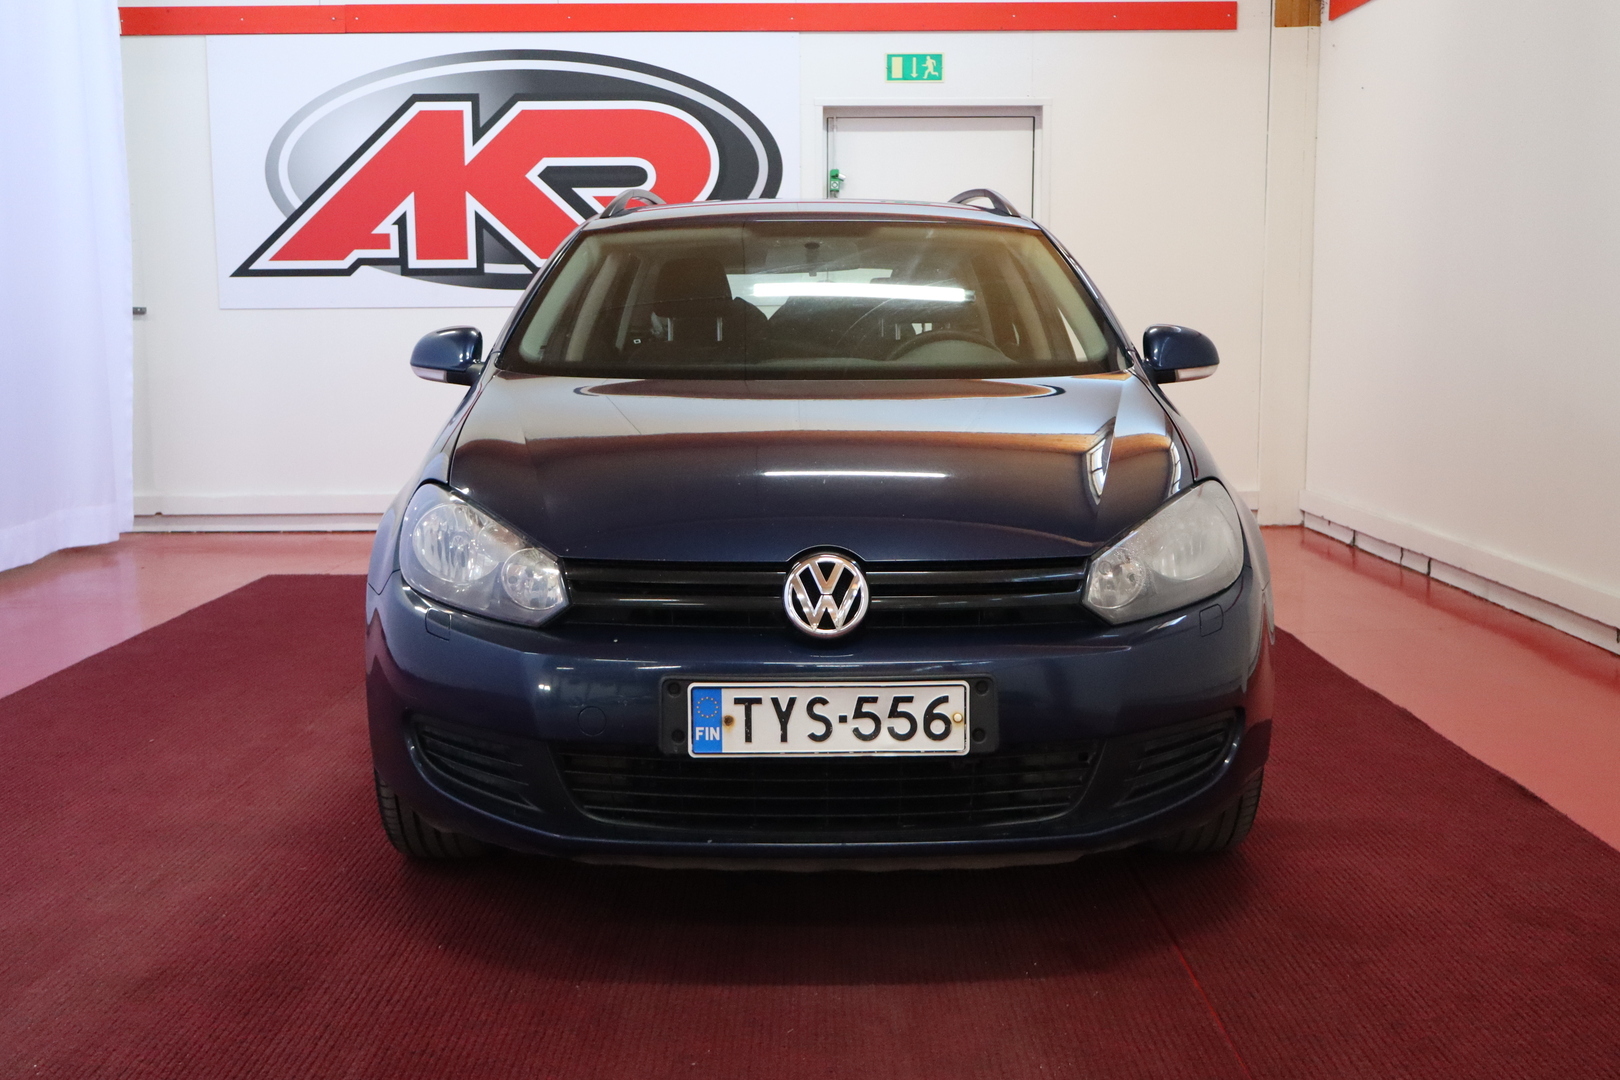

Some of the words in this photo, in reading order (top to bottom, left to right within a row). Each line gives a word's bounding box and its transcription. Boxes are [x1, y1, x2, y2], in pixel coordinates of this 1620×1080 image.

[785, 555, 868, 637] VW
[696, 727, 720, 741] FIN
[733, 695, 953, 743] TYS-556
